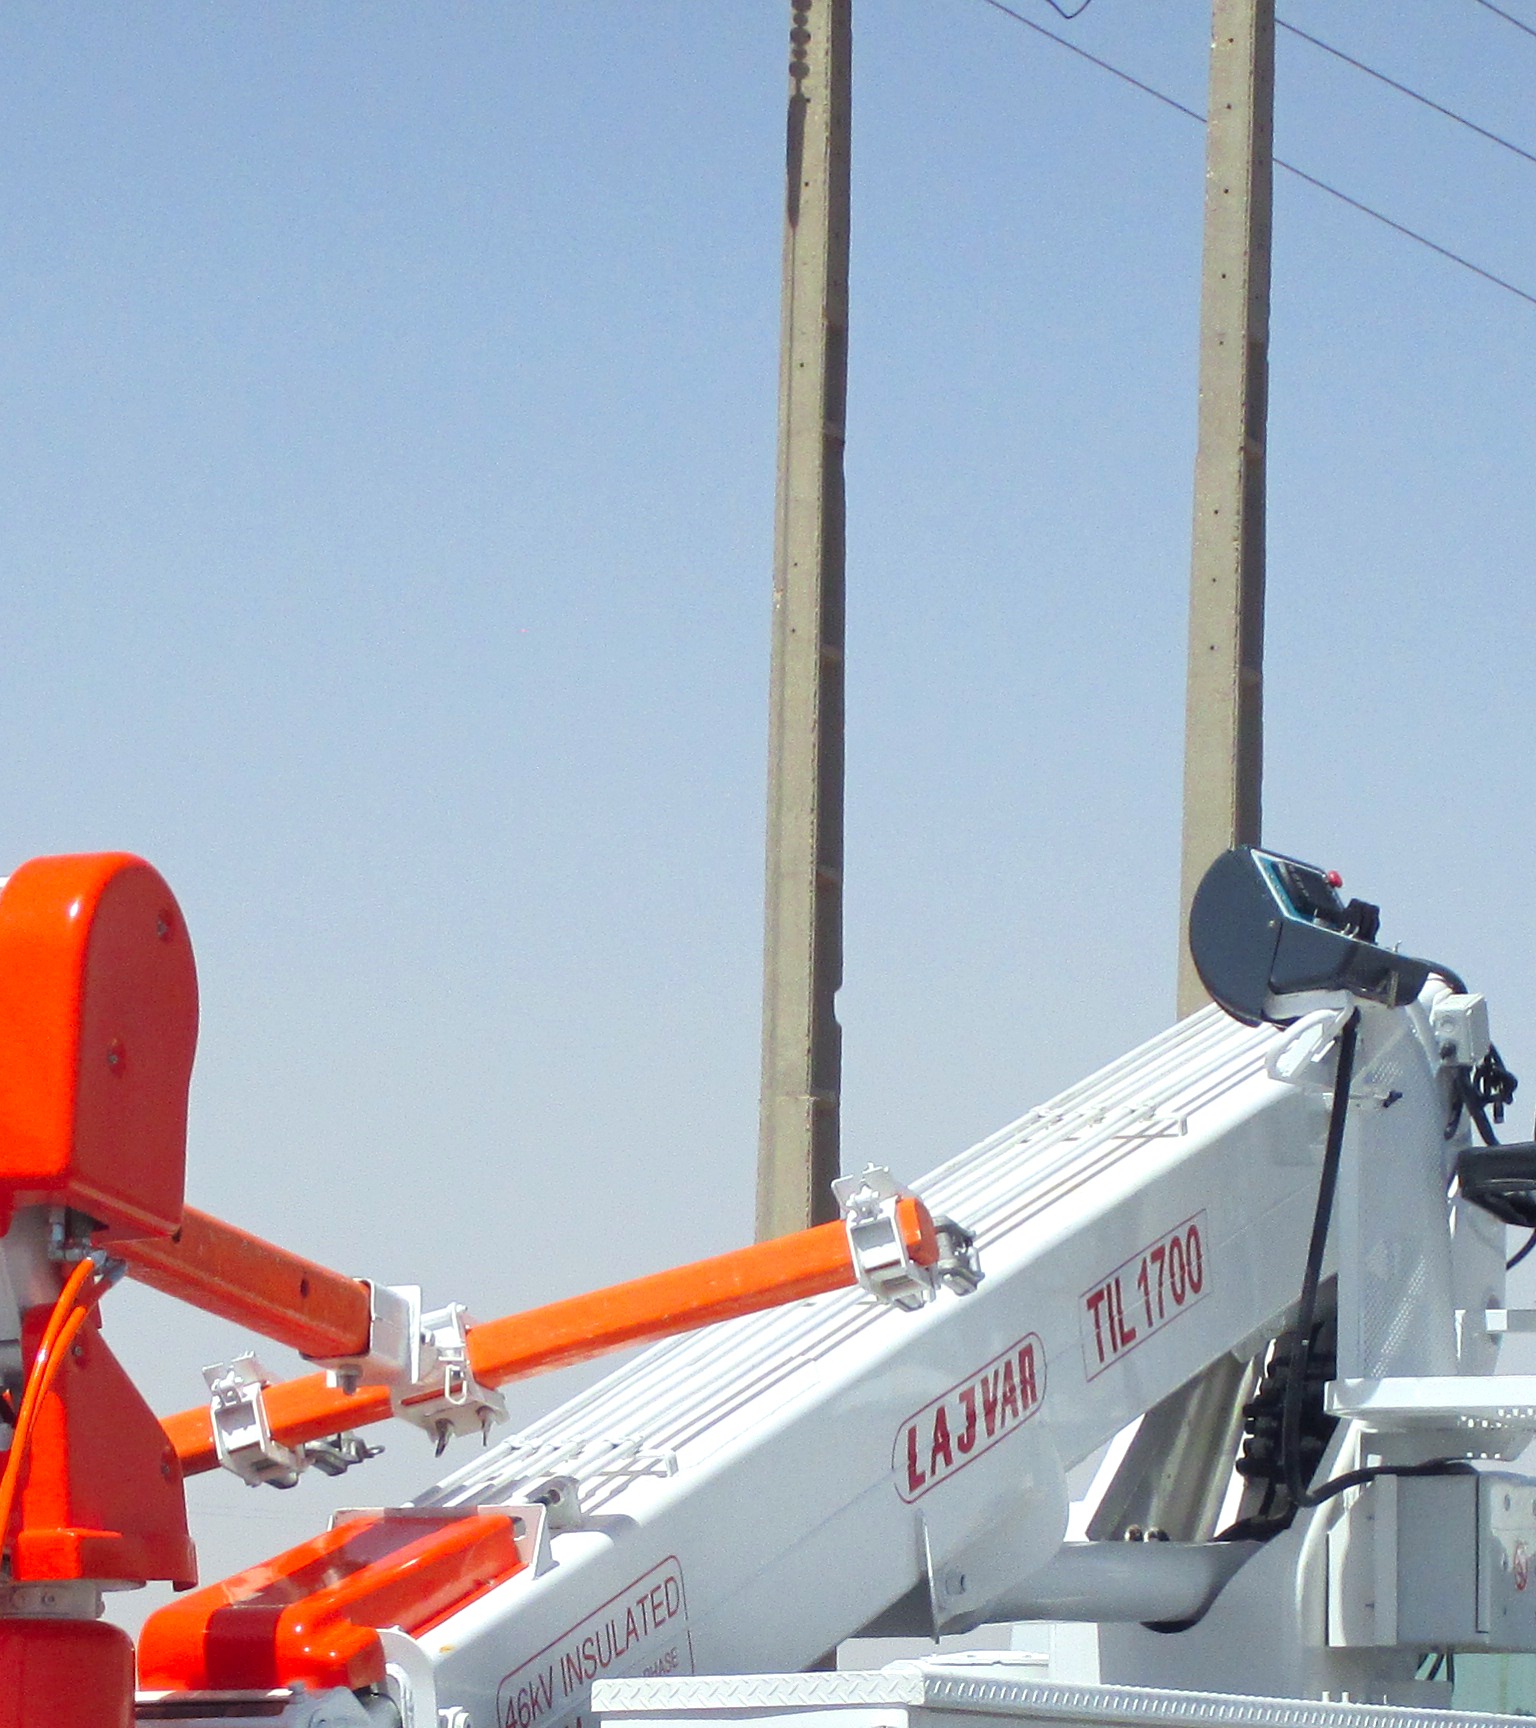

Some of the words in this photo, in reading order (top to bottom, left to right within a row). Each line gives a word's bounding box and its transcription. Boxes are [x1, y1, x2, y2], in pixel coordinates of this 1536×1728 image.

[1086, 1276, 1137, 1363] TIL
[1137, 1224, 1203, 1328] 1700
[906, 1342, 1038, 1494] LAJVAR
[560, 1576, 680, 1697] INSULATED
